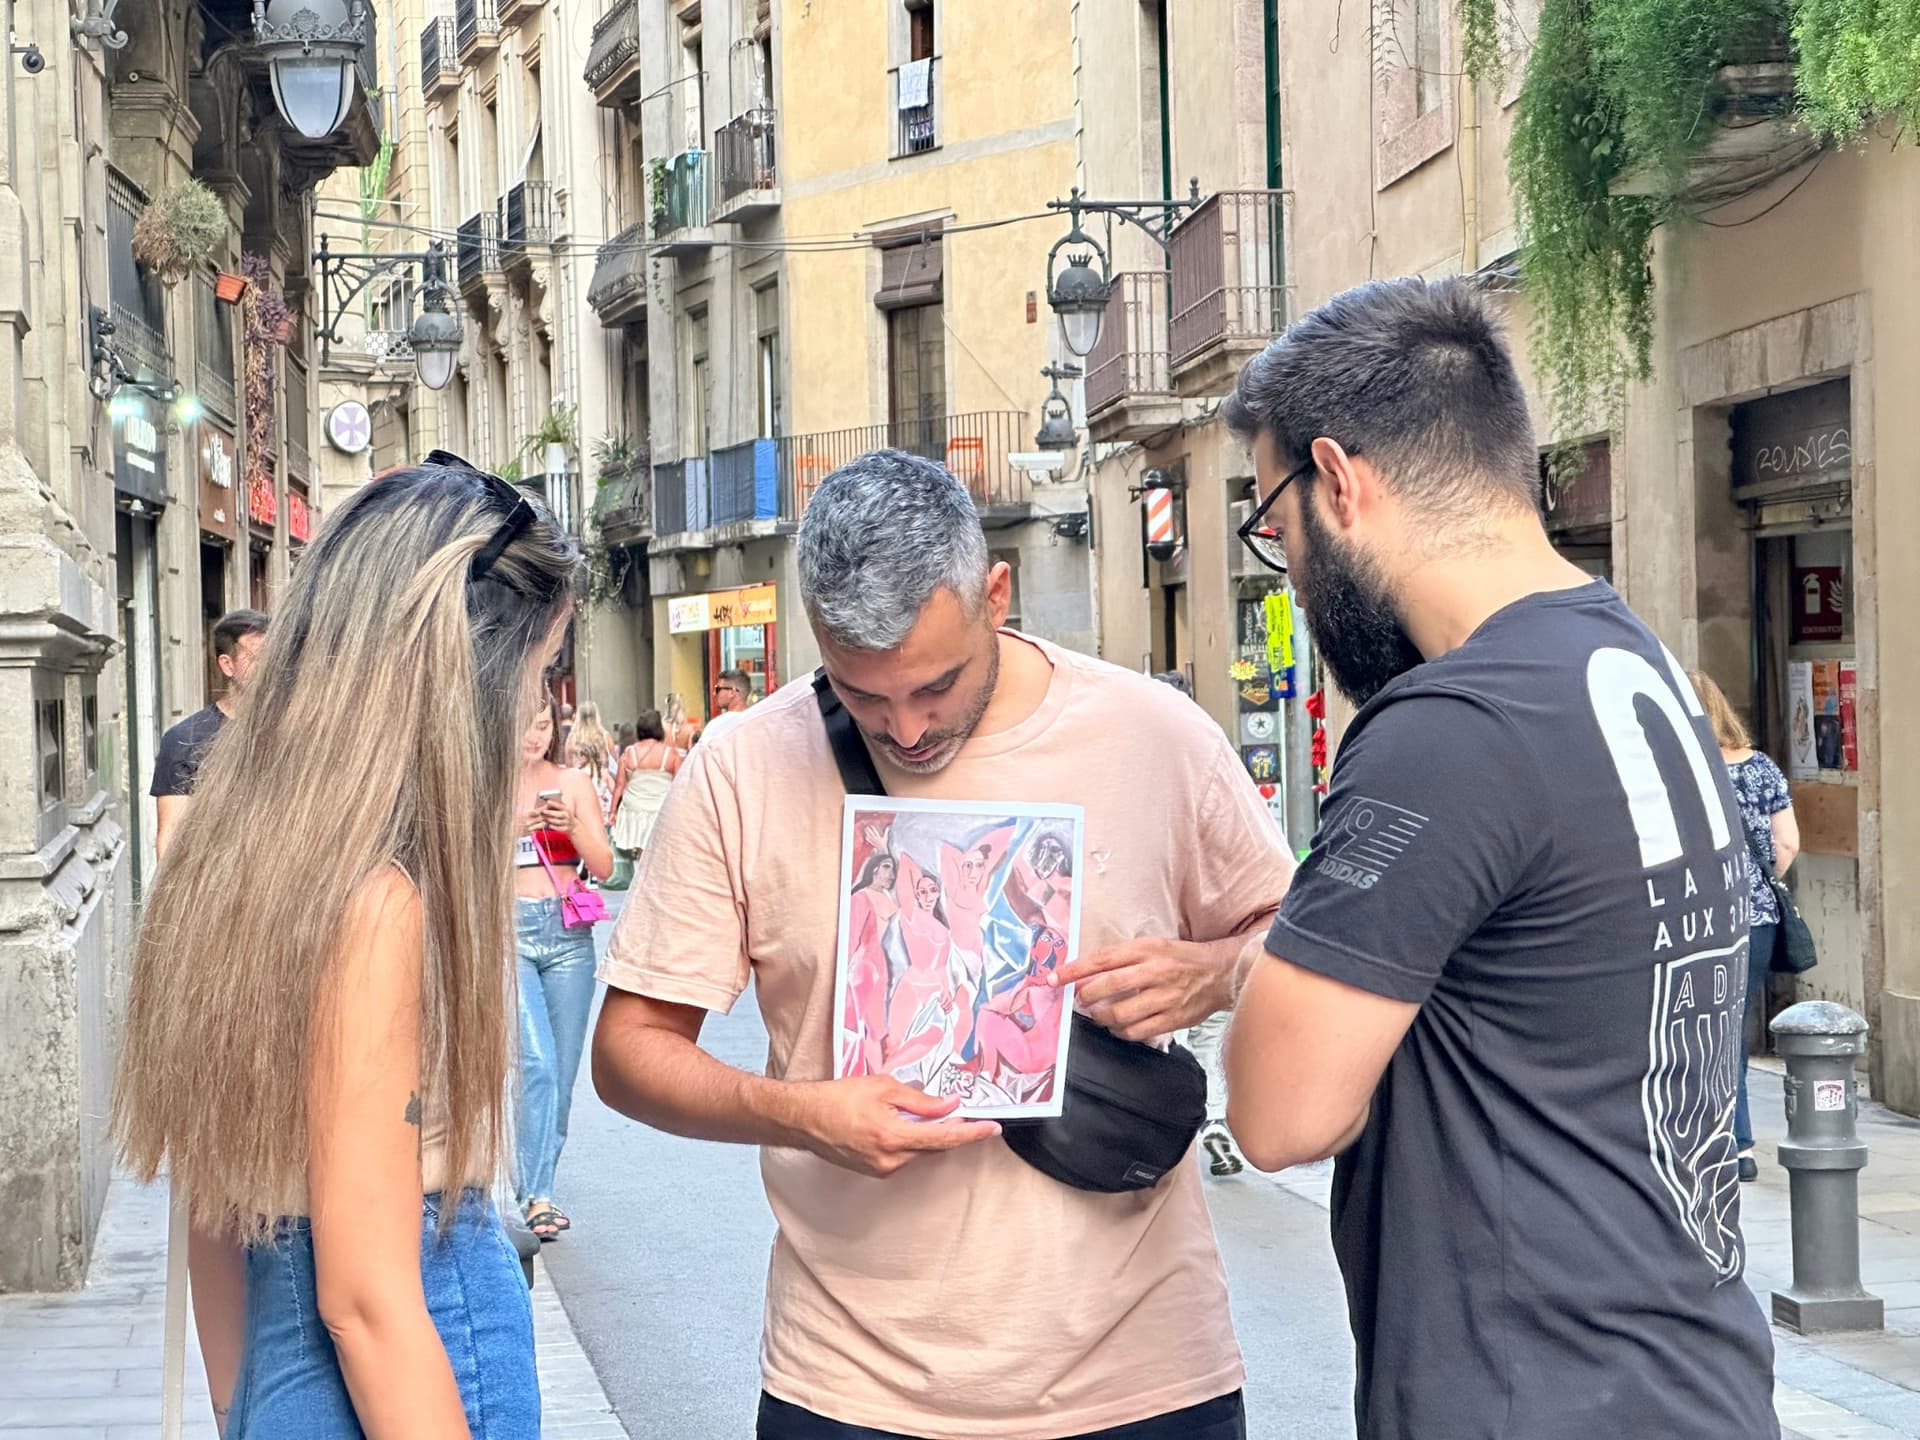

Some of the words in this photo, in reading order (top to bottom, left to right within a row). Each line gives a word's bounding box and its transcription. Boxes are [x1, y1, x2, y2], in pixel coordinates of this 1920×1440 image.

[1316, 857, 1379, 890] ADIDAS
[1646, 867, 1698, 908] LA
[1653, 907, 1715, 952] AUX
